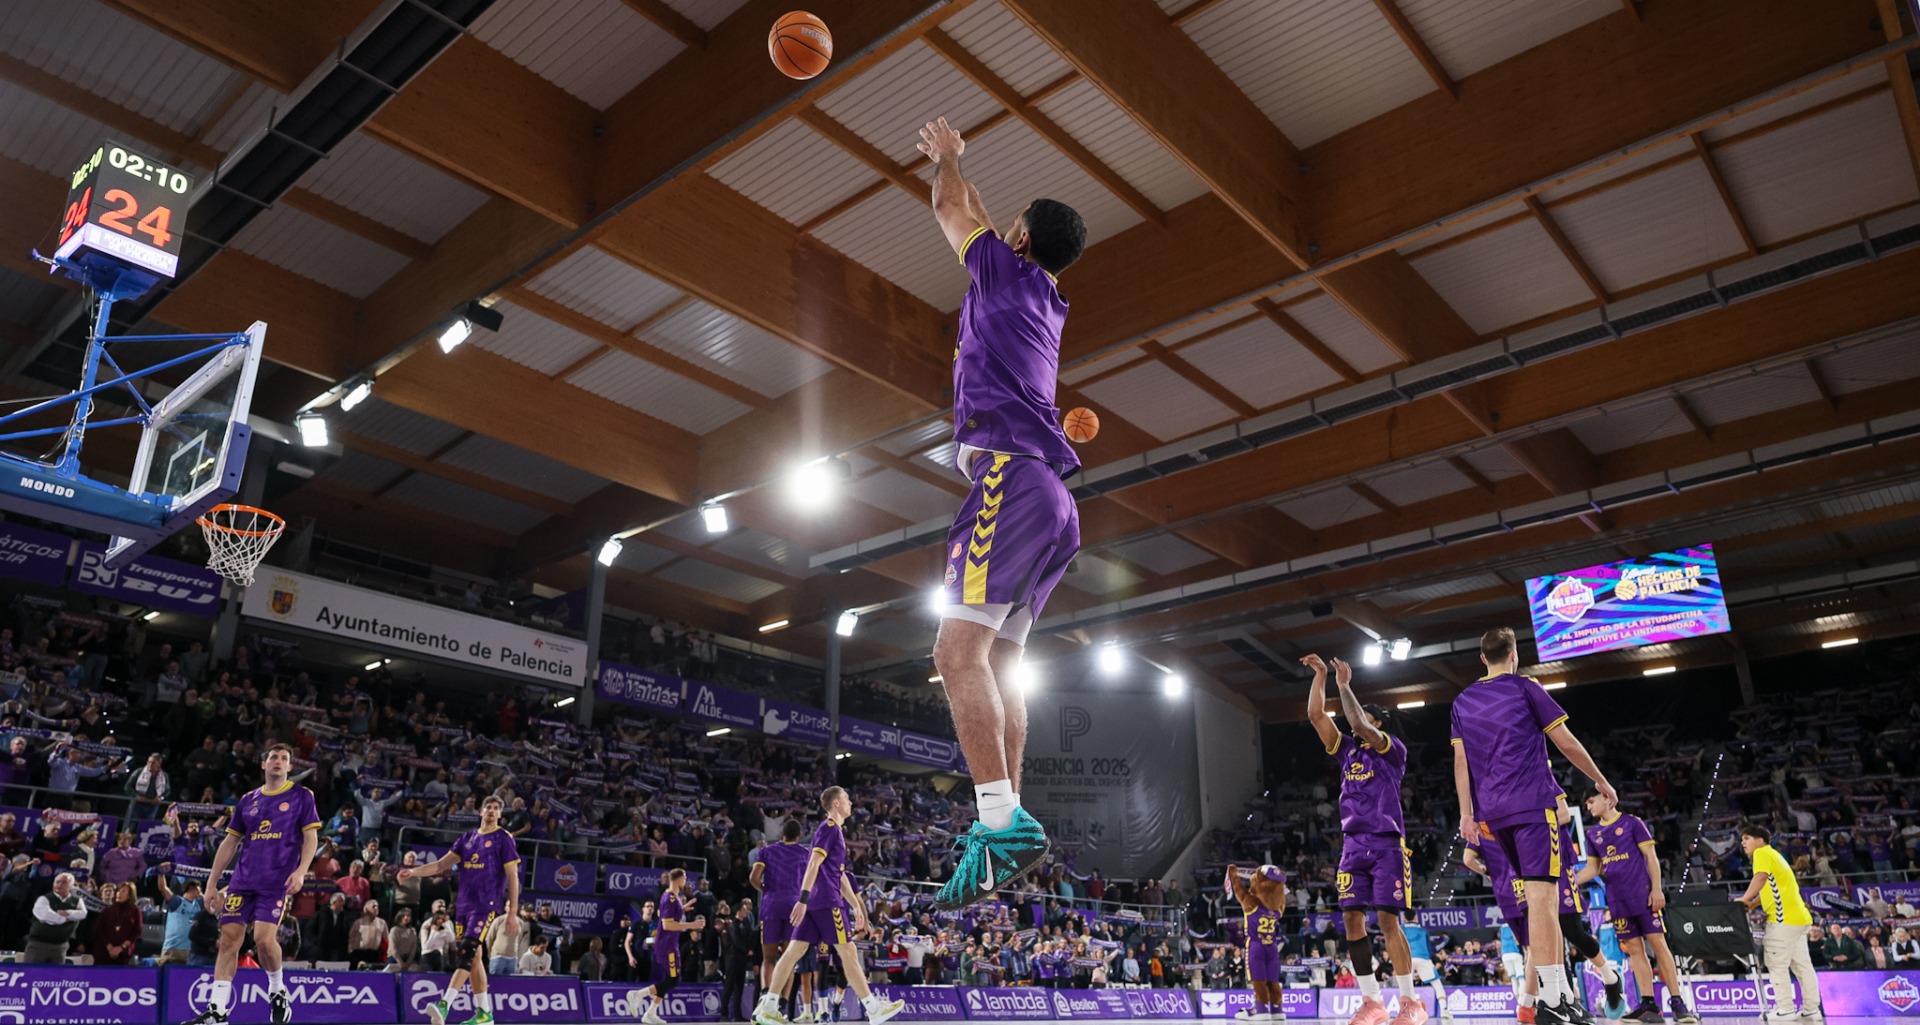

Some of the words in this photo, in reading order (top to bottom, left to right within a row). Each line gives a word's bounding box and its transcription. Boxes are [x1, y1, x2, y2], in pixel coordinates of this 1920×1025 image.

[109, 147, 188, 194] 02:10
[59, 186, 92, 246] 24
[98, 188, 172, 247] 24
[20, 477, 75, 498] MONDO
[129, 562, 215, 589] Transportes
[1637, 568, 1684, 587] HECHOS
[1684, 565, 1702, 578] DE
[122, 576, 216, 604] BUJ
[1639, 578, 1700, 598] PALENCIA
[1550, 592, 1591, 610] PALENCIA
[1562, 633, 1572, 641] AL
[1573, 625, 1612, 639] IMPULSO
[1613, 622, 1625, 631] DE
[1627, 620, 1639, 629] LA
[1575, 632, 1619, 647] INSTITUYE
[1620, 631, 1632, 640] LA
[316, 606, 459, 653] Ayuntamiento
[468, 641, 492, 660] de
[500, 647, 573, 677] Palencia
[625, 679, 679, 708] Valdés
[698, 703, 722, 719] ALDE
[1022, 757, 1084, 776] PALENCIA
[1091, 758, 1130, 776] 2026
[535, 898, 598, 919] BNVENIDOS
[1421, 910, 1467, 927] PETKUS
[1257, 917, 1277, 933] 23
[1706, 925, 1733, 933] Wilson
[32, 980, 90, 988] consultores
[290, 976, 334, 984] GRUPO
[31, 987, 157, 1006] MODOS
[241, 984, 379, 1004] INMAPA
[900, 990, 945, 1000] HOTEL
[982, 990, 1047, 1010] lambda
[1228, 993, 1313, 1005] DENEDIC
[1470, 991, 1515, 1001] HERRERO
[1695, 984, 1756, 1005] Grupo
[1880, 989, 1917, 1001] PALENCIA
[602, 992, 687, 1017] famlia
[900, 1002, 918, 1014] REY
[919, 1002, 957, 1015] SANCHO
